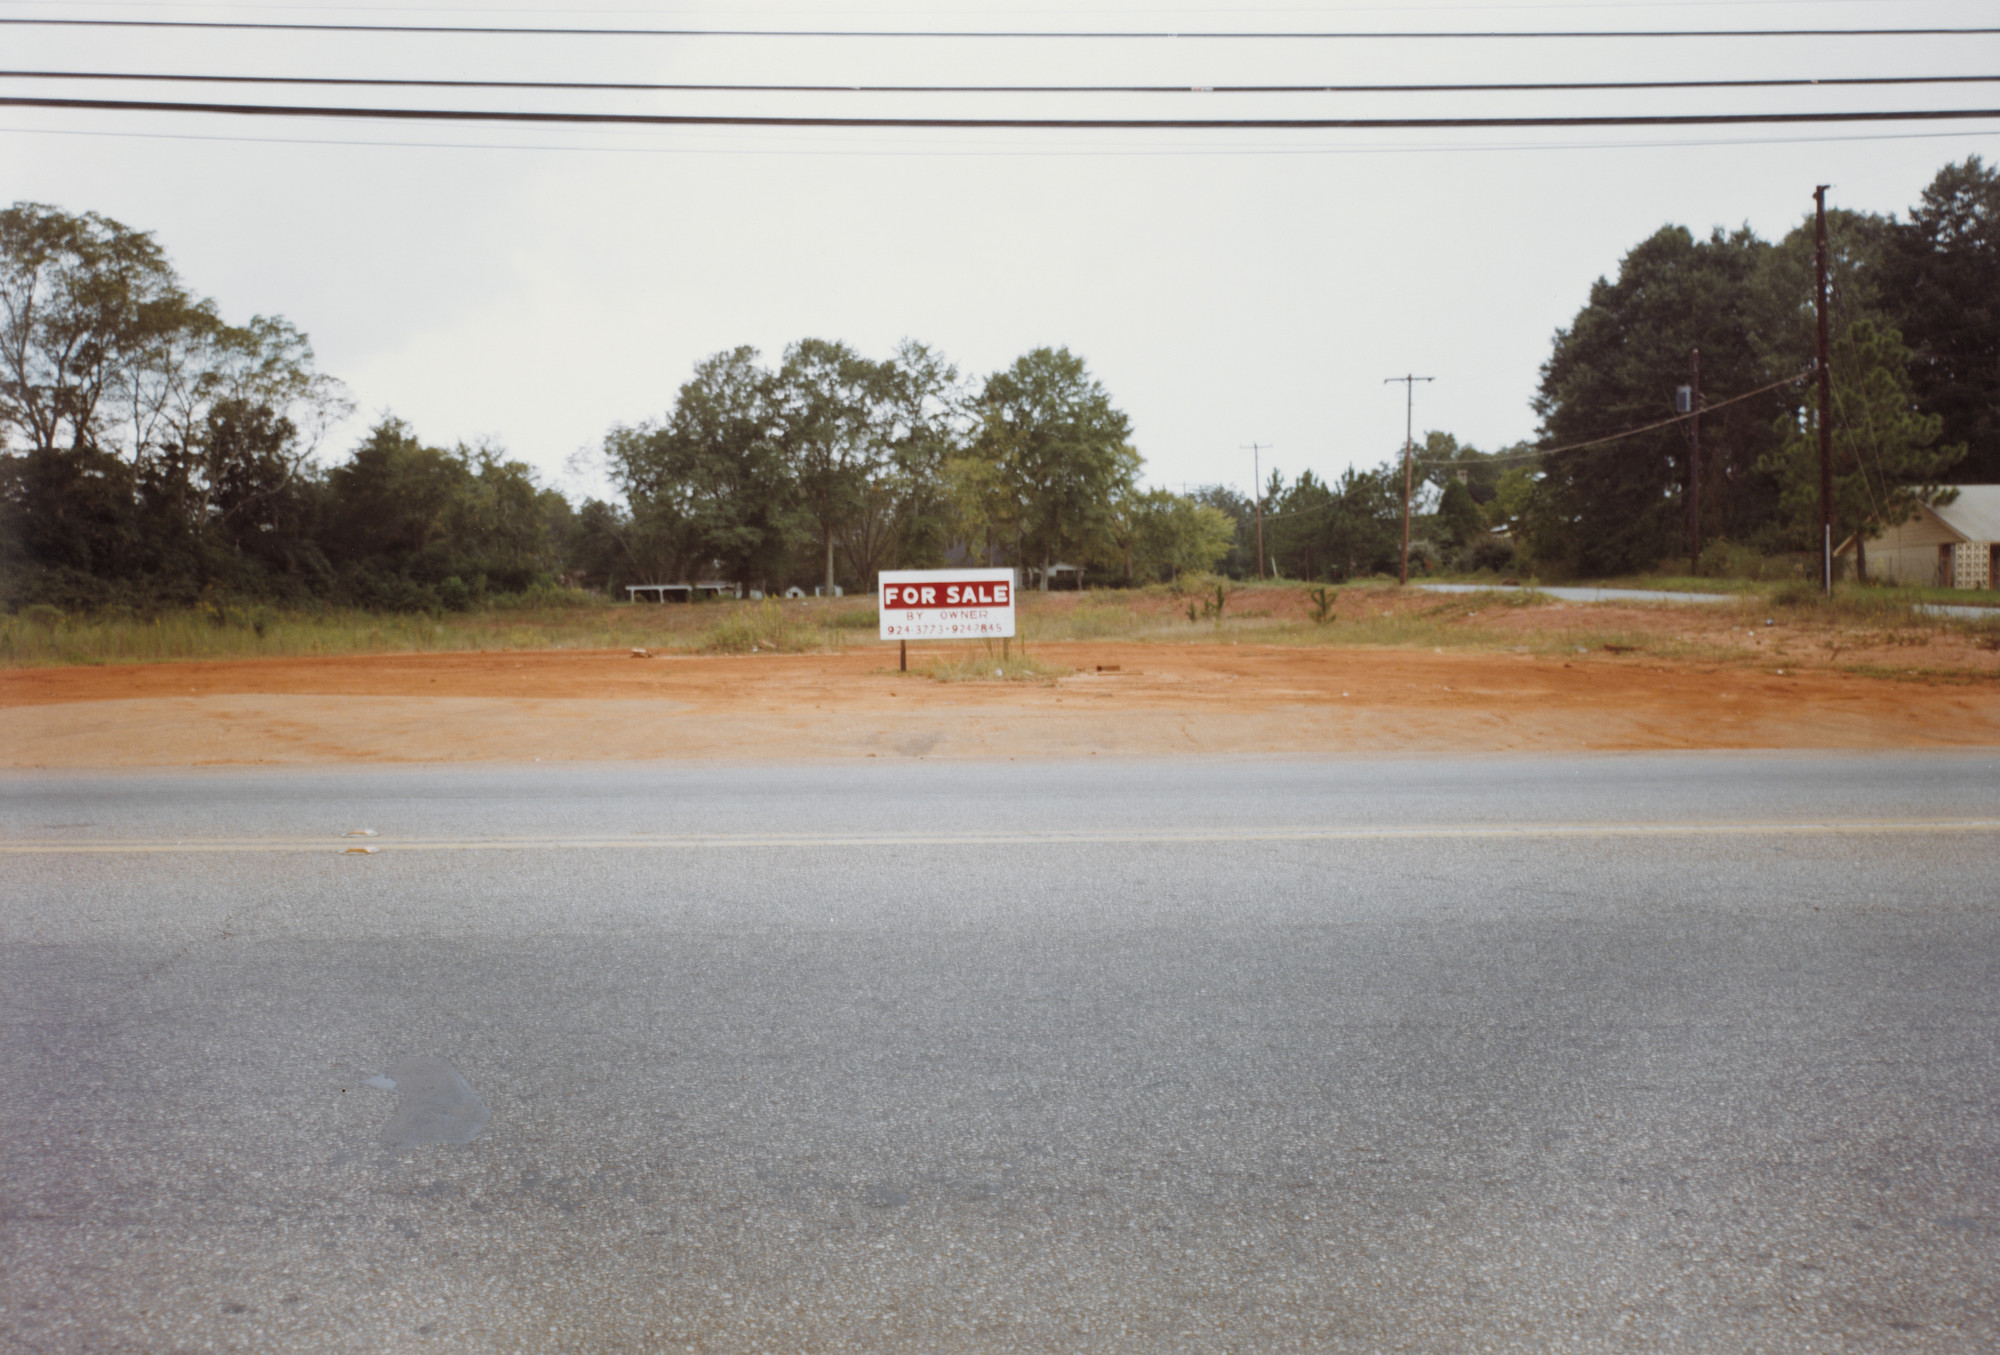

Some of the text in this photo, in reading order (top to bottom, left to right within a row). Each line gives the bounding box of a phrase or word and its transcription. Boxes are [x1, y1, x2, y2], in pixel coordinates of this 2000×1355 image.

[885, 585, 1008, 605] FOR SALE
[906, 610, 988, 621] BY OWNER
